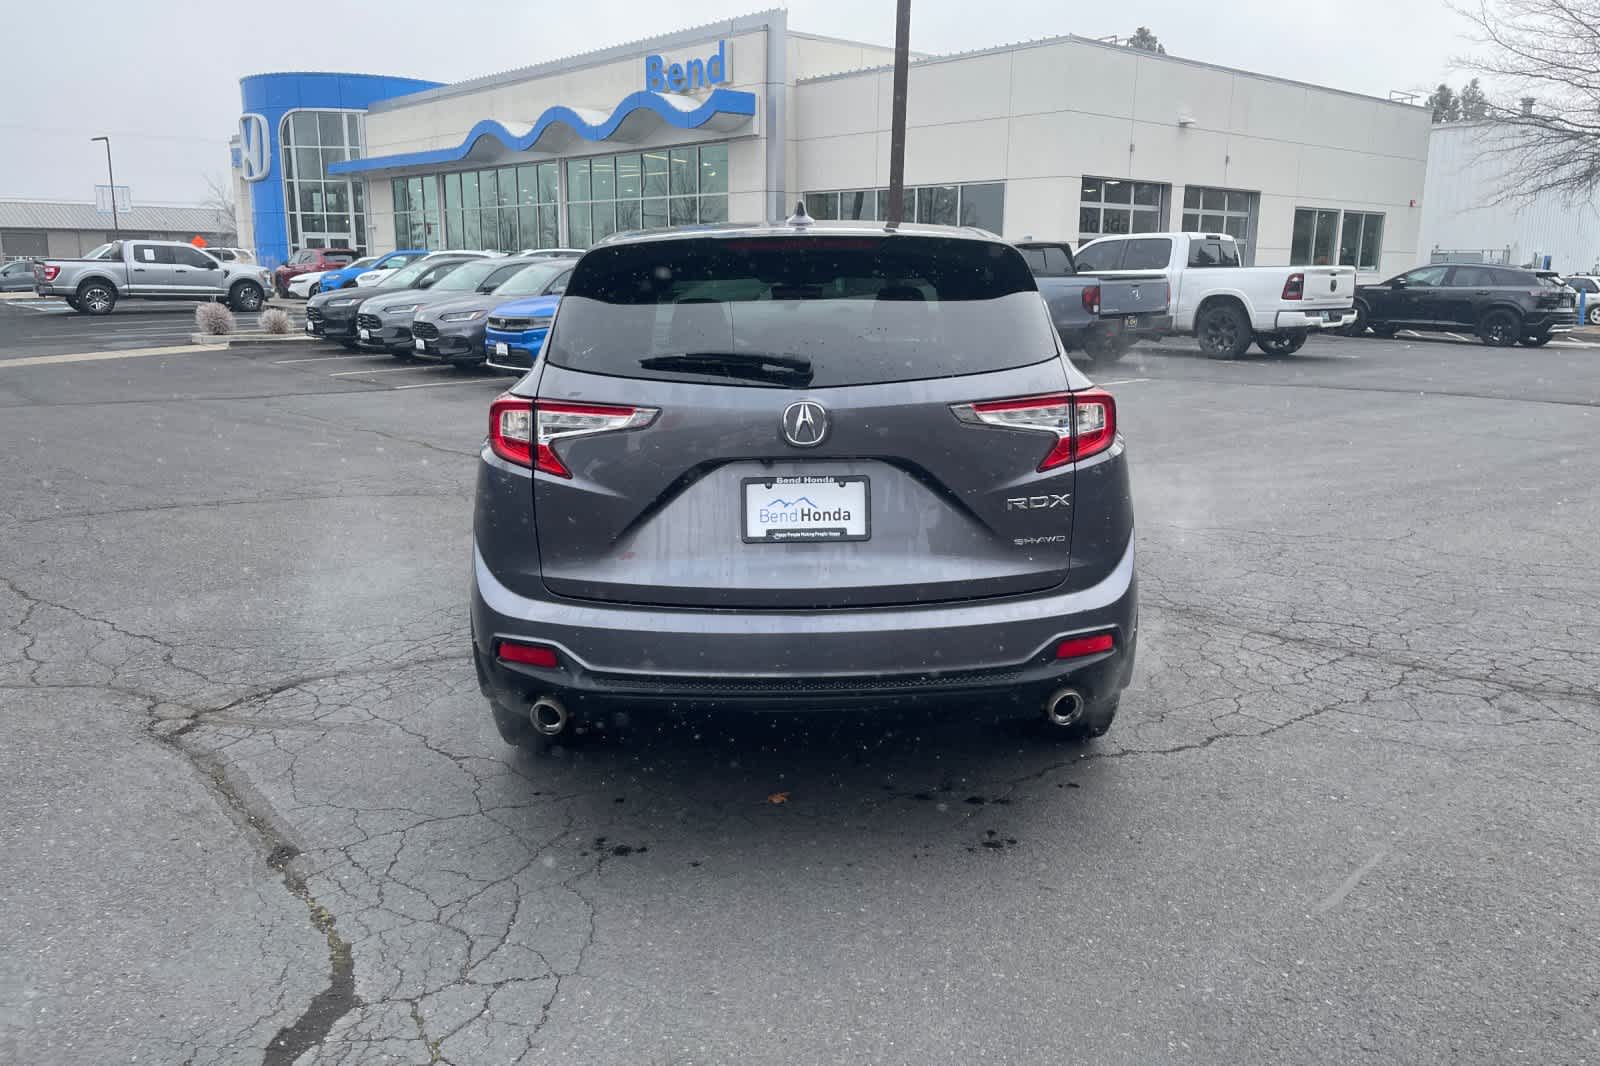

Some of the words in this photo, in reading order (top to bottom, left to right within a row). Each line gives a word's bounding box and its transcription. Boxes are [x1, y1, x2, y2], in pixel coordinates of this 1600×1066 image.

[646, 40, 724, 92] Bend
[803, 476, 835, 484] Honda
[1007, 493, 1071, 510] RDX
